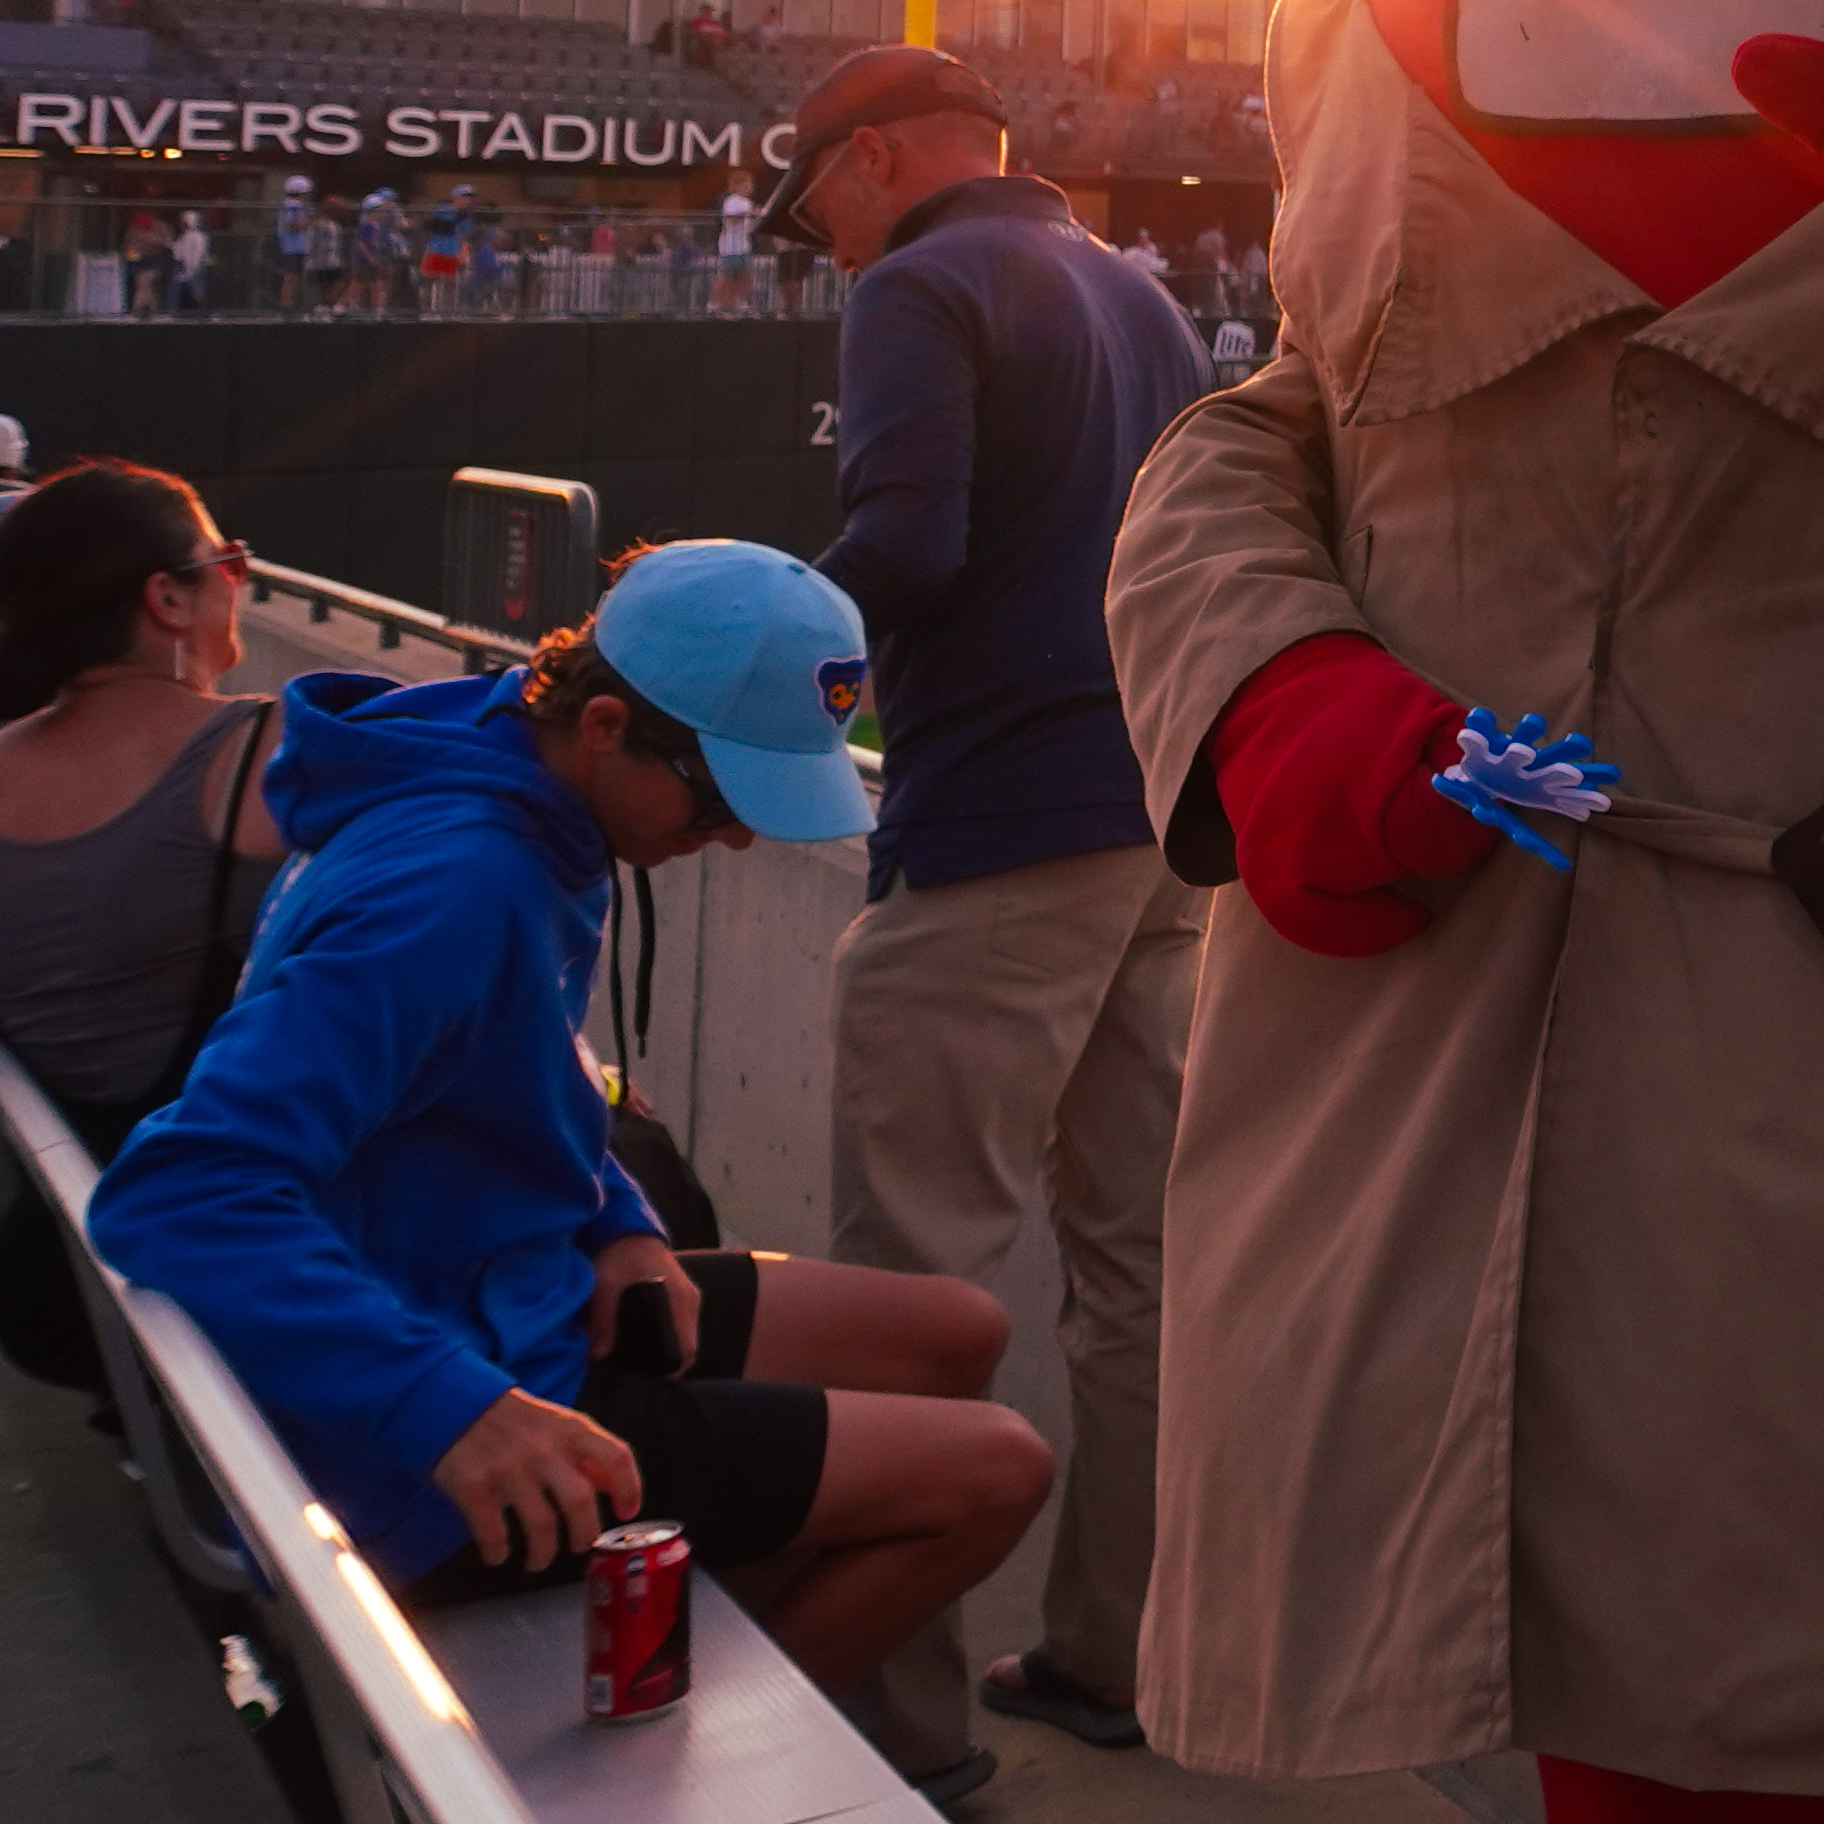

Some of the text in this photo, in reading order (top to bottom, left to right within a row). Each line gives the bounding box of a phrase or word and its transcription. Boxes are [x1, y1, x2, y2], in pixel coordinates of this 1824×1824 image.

[16, 92, 363, 155] RIVERS
[384, 106, 742, 167] STADIUM
[810, 401, 841, 445] 2
